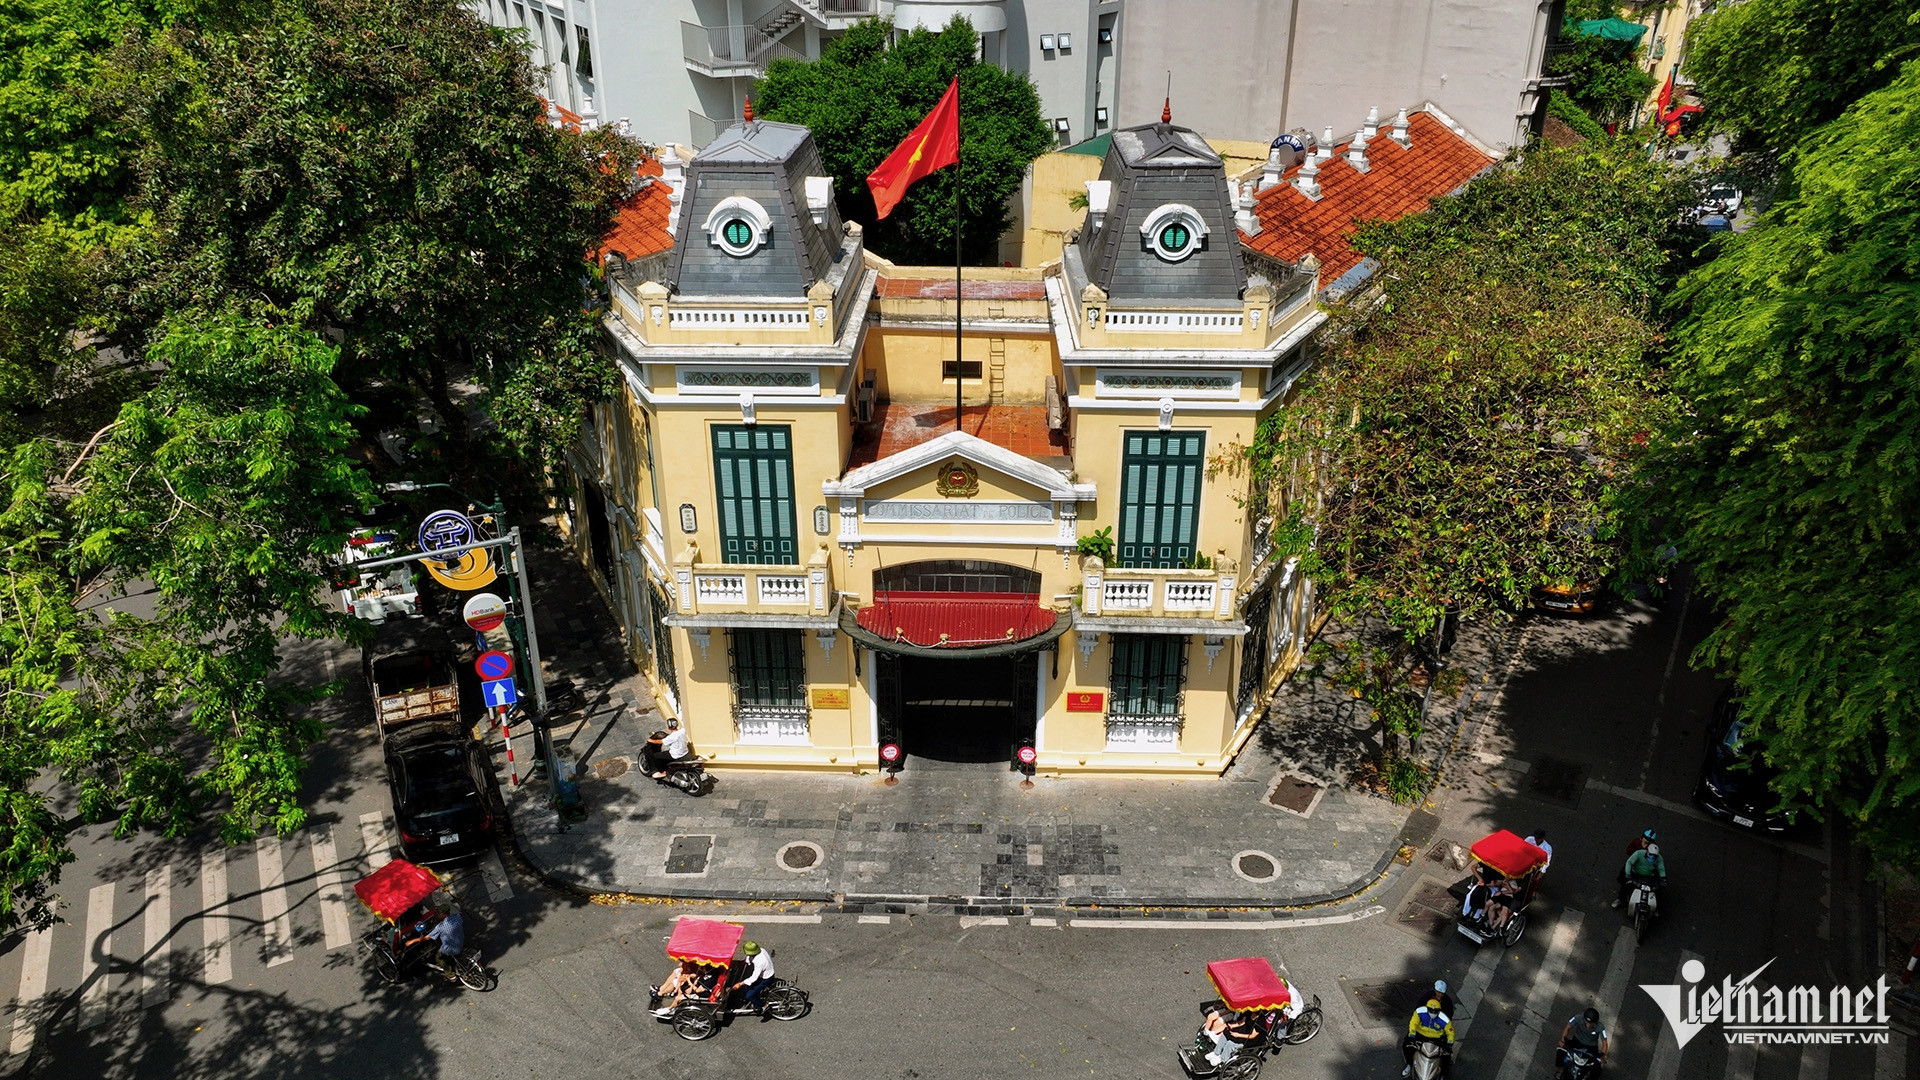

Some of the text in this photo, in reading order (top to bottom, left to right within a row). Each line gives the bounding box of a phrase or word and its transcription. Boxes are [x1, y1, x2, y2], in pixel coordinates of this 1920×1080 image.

[869, 503, 980, 518] COMMISSARIAT
[999, 505, 1049, 519] POLICE
[471, 606, 495, 616] HDBank
